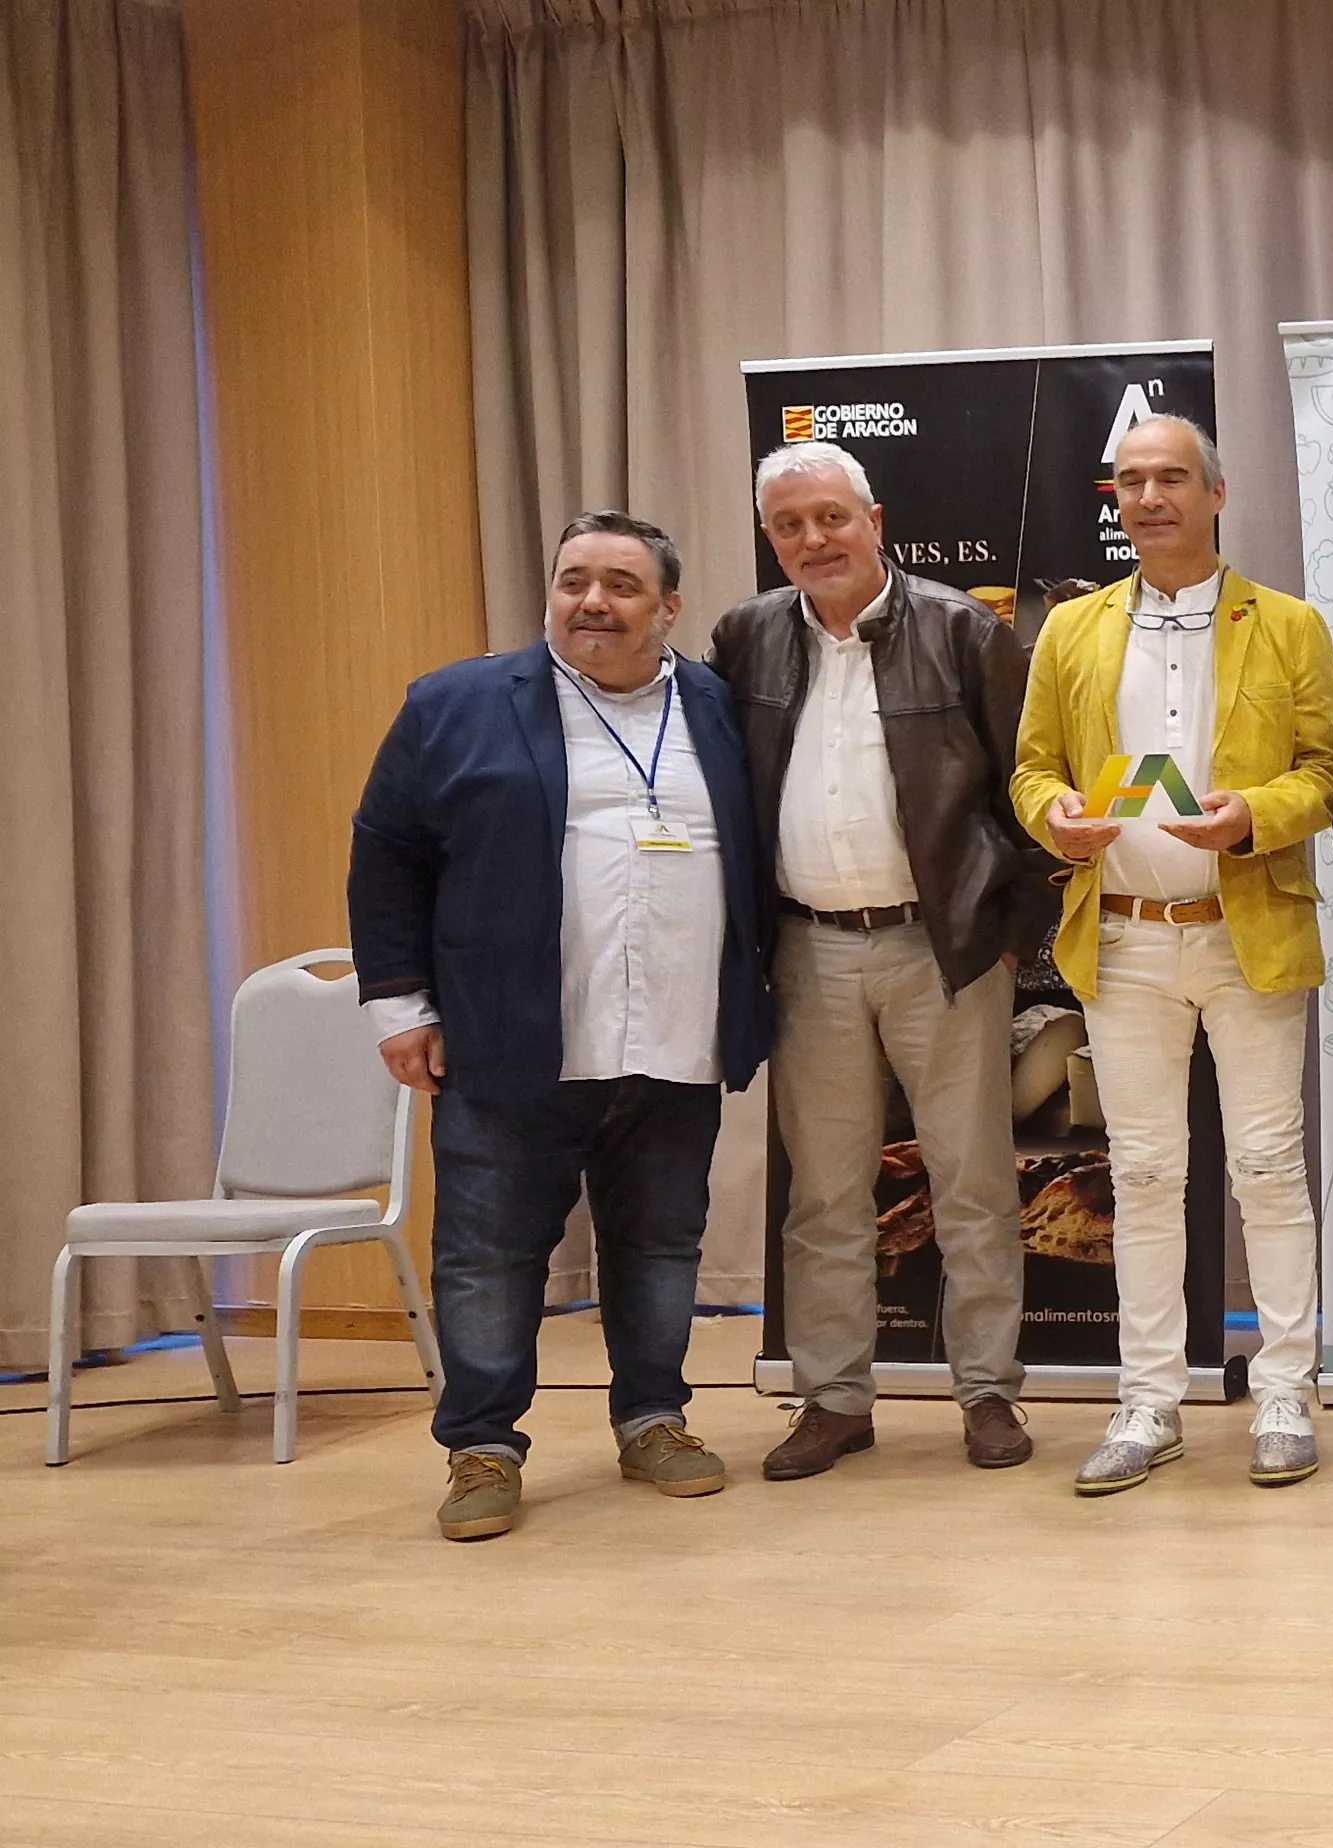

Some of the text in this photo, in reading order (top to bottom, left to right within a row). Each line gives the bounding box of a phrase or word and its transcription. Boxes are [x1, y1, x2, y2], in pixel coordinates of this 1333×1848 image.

[815, 403, 904, 422] GOBIERNO
[815, 423, 838, 439] DE
[893, 540, 997, 564] VES, ES.
[1021, 1308, 1119, 1322] nalimentosn
